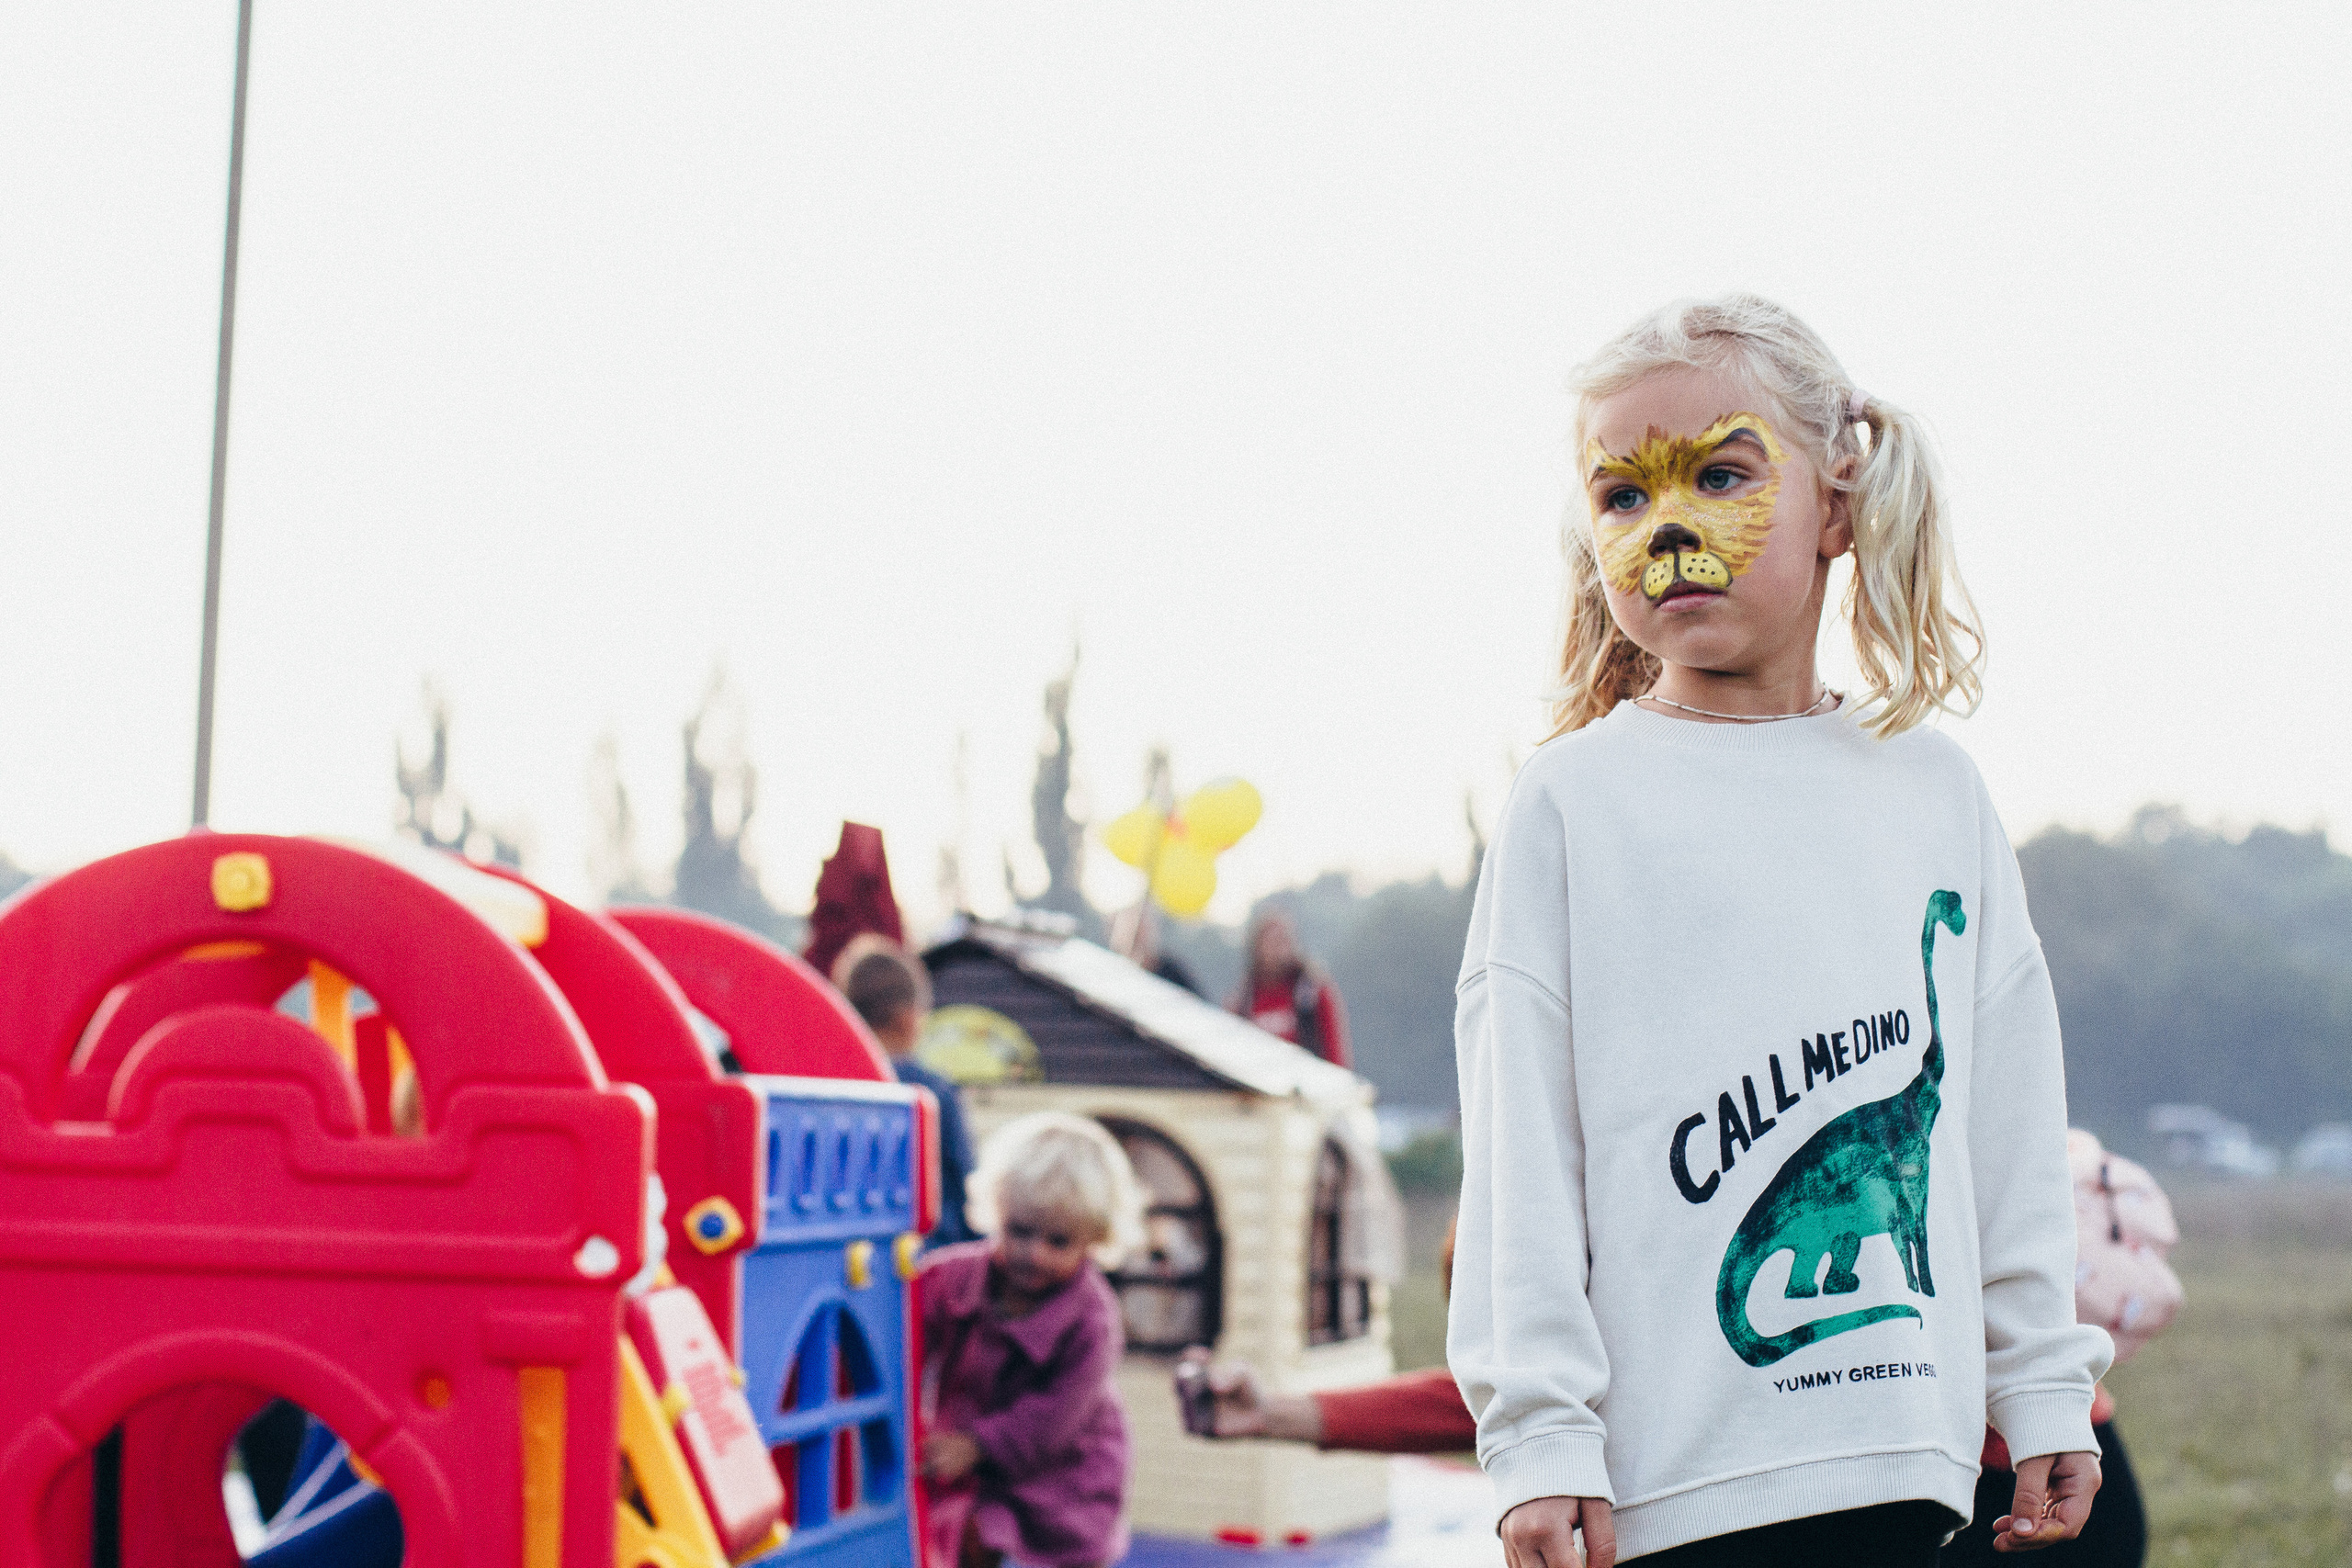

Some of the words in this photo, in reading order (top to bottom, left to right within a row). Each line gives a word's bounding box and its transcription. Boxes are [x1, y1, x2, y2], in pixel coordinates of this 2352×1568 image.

[1669, 1054, 1801, 1204] CALL
[1773, 1370, 1843, 1393] YUMMY
[1849, 1362, 1912, 1382] GREEN
